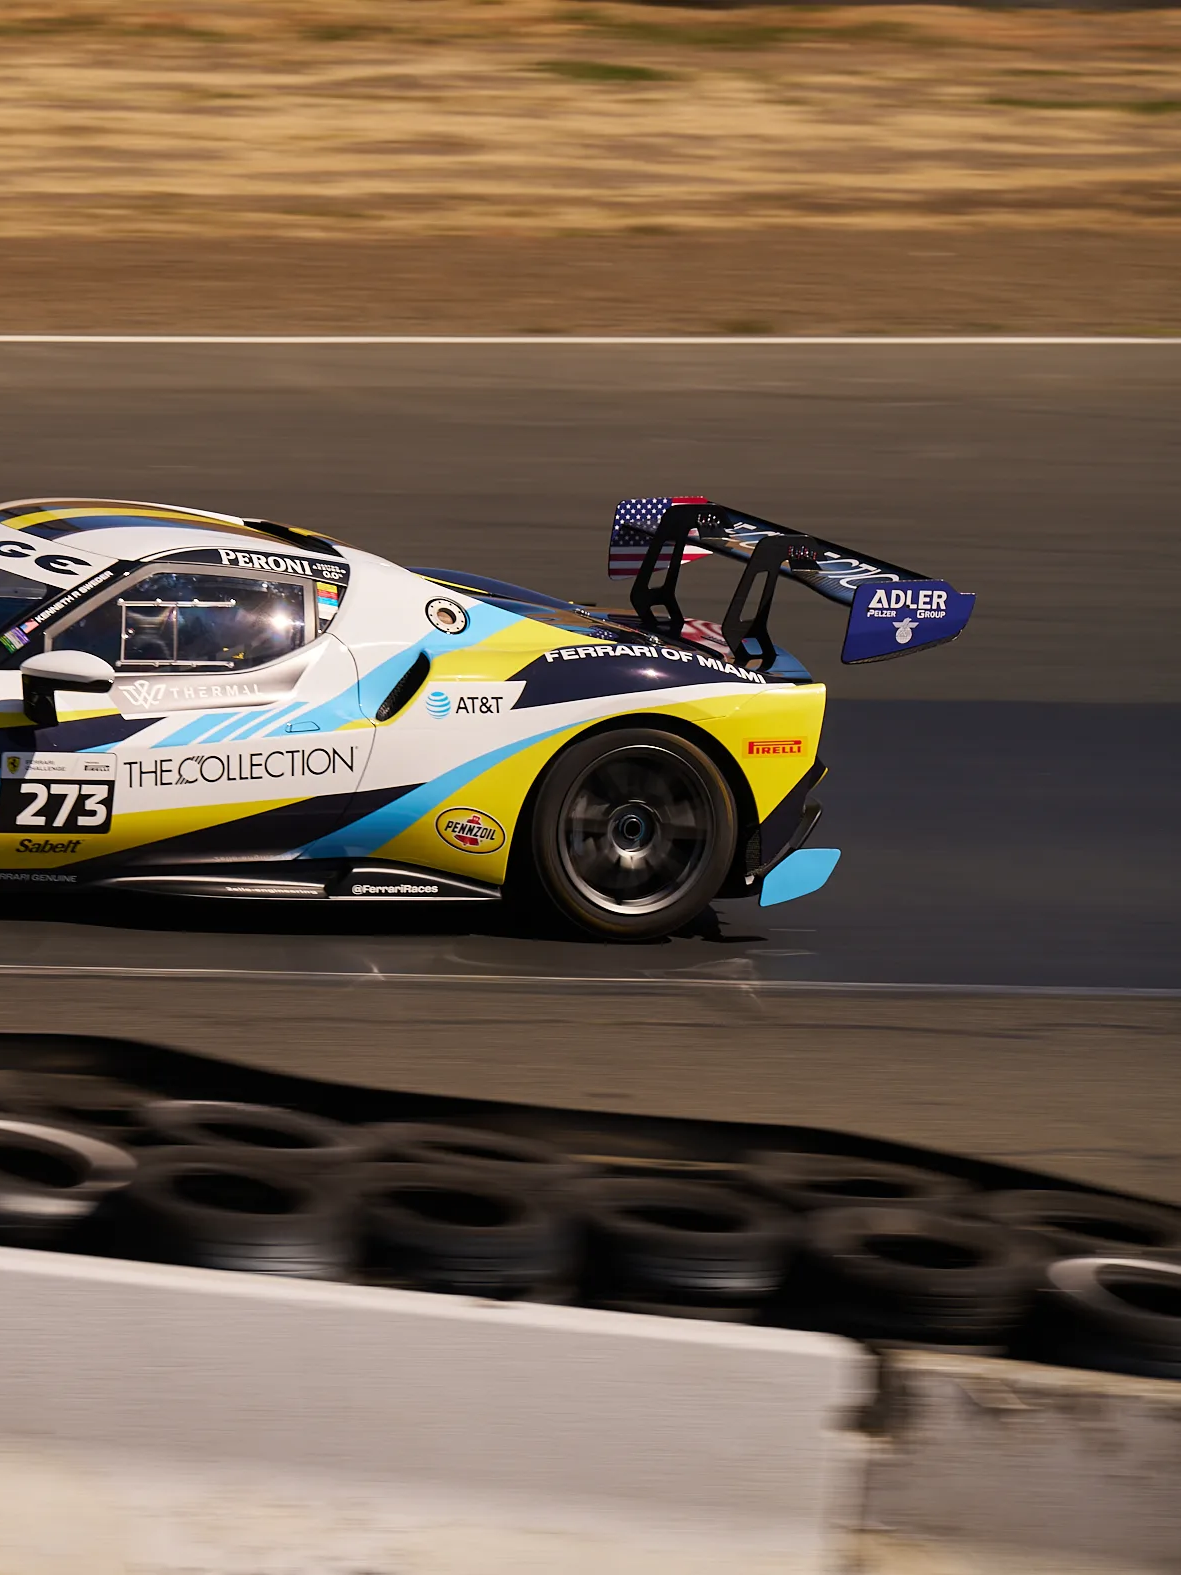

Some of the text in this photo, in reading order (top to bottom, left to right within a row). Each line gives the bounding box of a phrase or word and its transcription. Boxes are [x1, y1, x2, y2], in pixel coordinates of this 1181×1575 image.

[218, 549, 313, 575] PERONI
[35, 571, 114, 623] KENNETH R SWEDER
[868, 589, 947, 609] ADLER
[867, 609, 946, 618] PELZER GROUP
[545, 645, 767, 684] FERRARI OF MIAMI
[170, 684, 262, 699] THERMAL
[456, 696, 503, 714] AT&T
[748, 740, 802, 754] PIRELLI
[123, 746, 355, 788] THE COLLECTION
[15, 783, 109, 827] 273
[444, 820, 497, 840] PENNZOIL
[15, 838, 82, 853] Sabelt
[31, 874, 77, 882] GENUINE
[352, 884, 438, 895] @FerrariRaces
